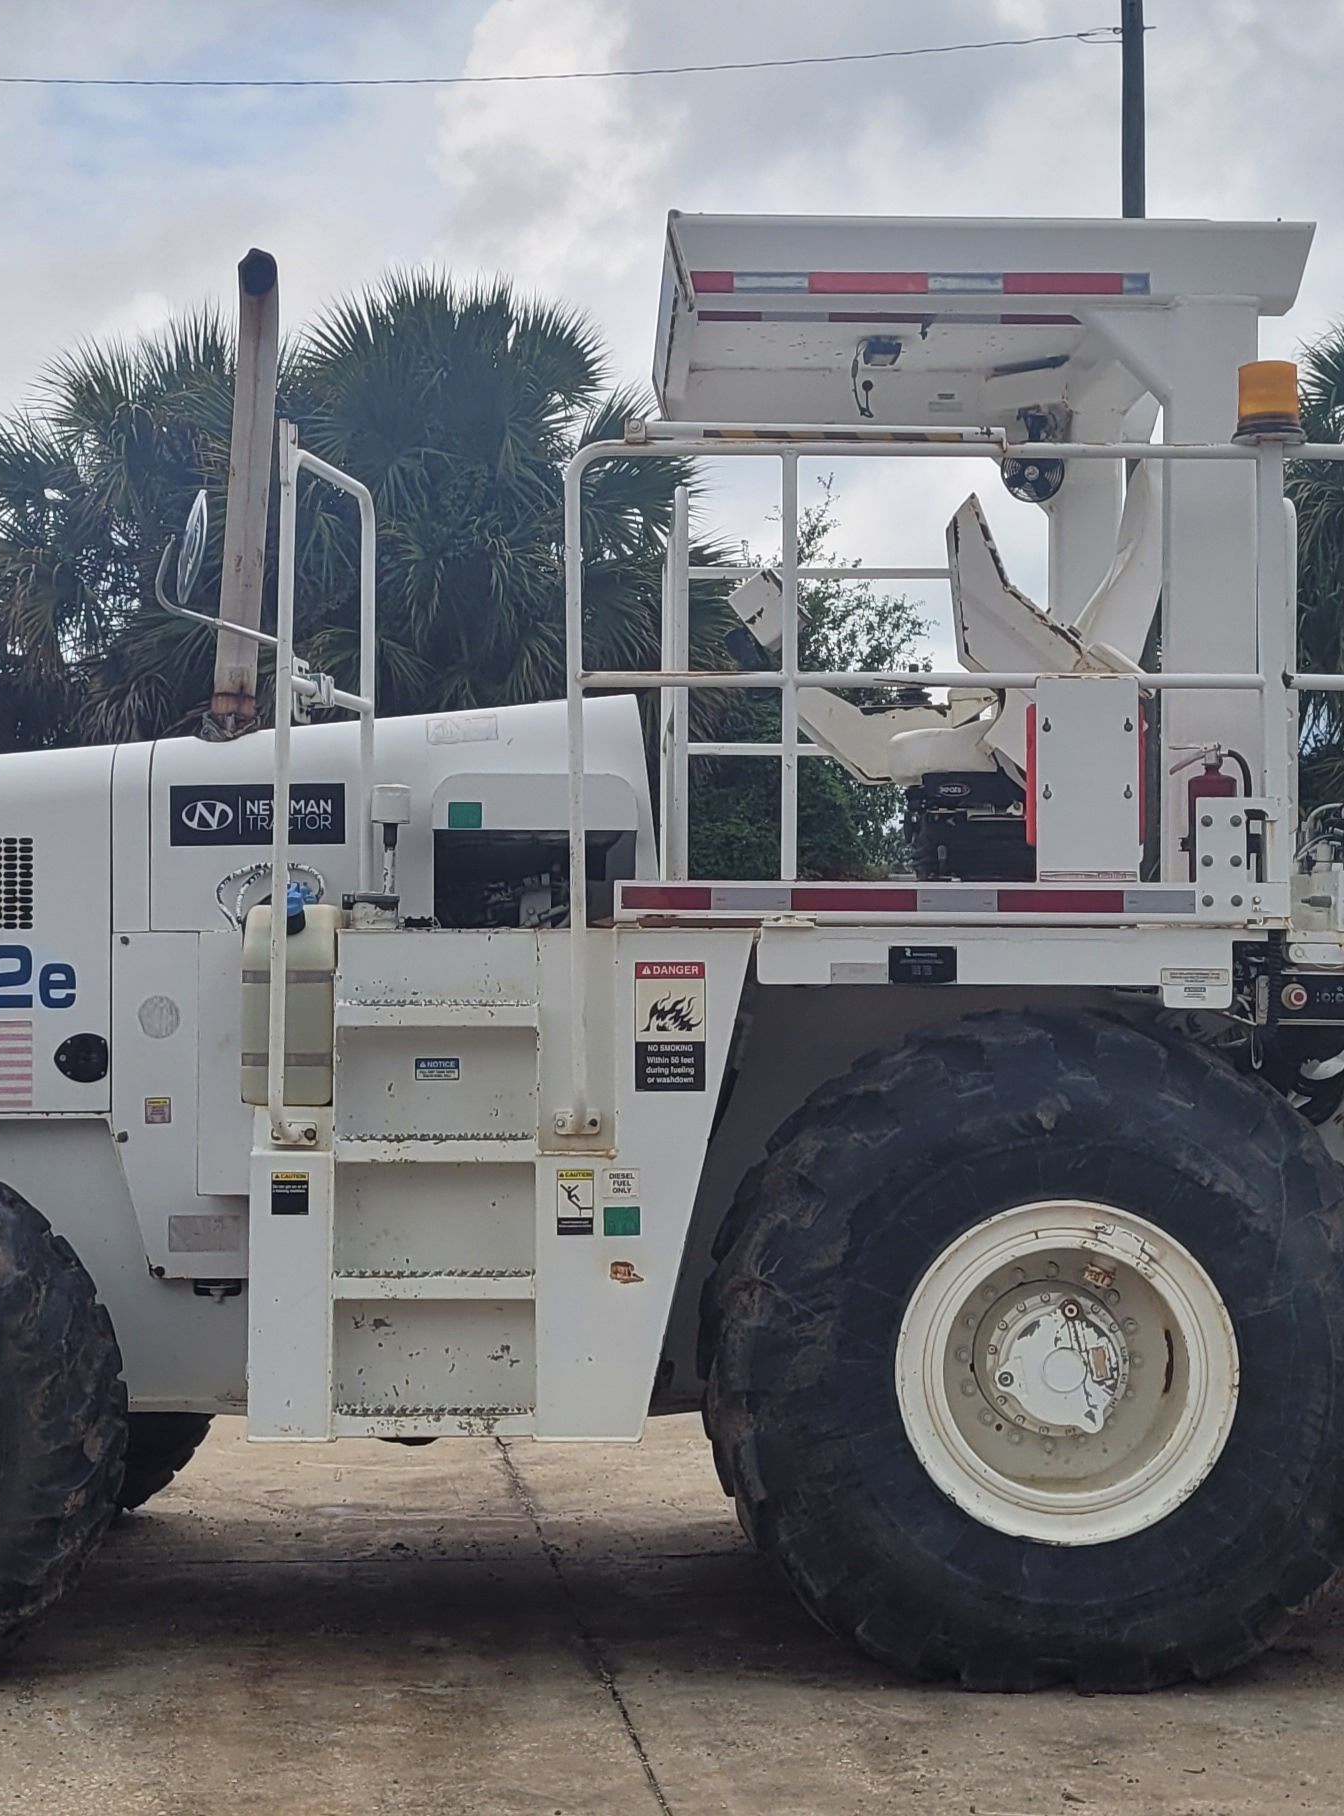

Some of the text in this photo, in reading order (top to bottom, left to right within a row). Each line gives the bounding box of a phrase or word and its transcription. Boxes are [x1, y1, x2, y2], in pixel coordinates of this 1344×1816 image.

[246, 799, 332, 815] NEMAN
[245, 814, 332, 831] TRTOR
[652, 966, 699, 975] DANGER
[647, 1044, 693, 1052] NO SMOKING
[427, 1060, 456, 1068] NOTICE
[646, 1056, 669, 1064] Within
[681, 1056, 695, 1064] feet
[646, 1066, 669, 1075] during
[656, 1076, 694, 1084] washdown
